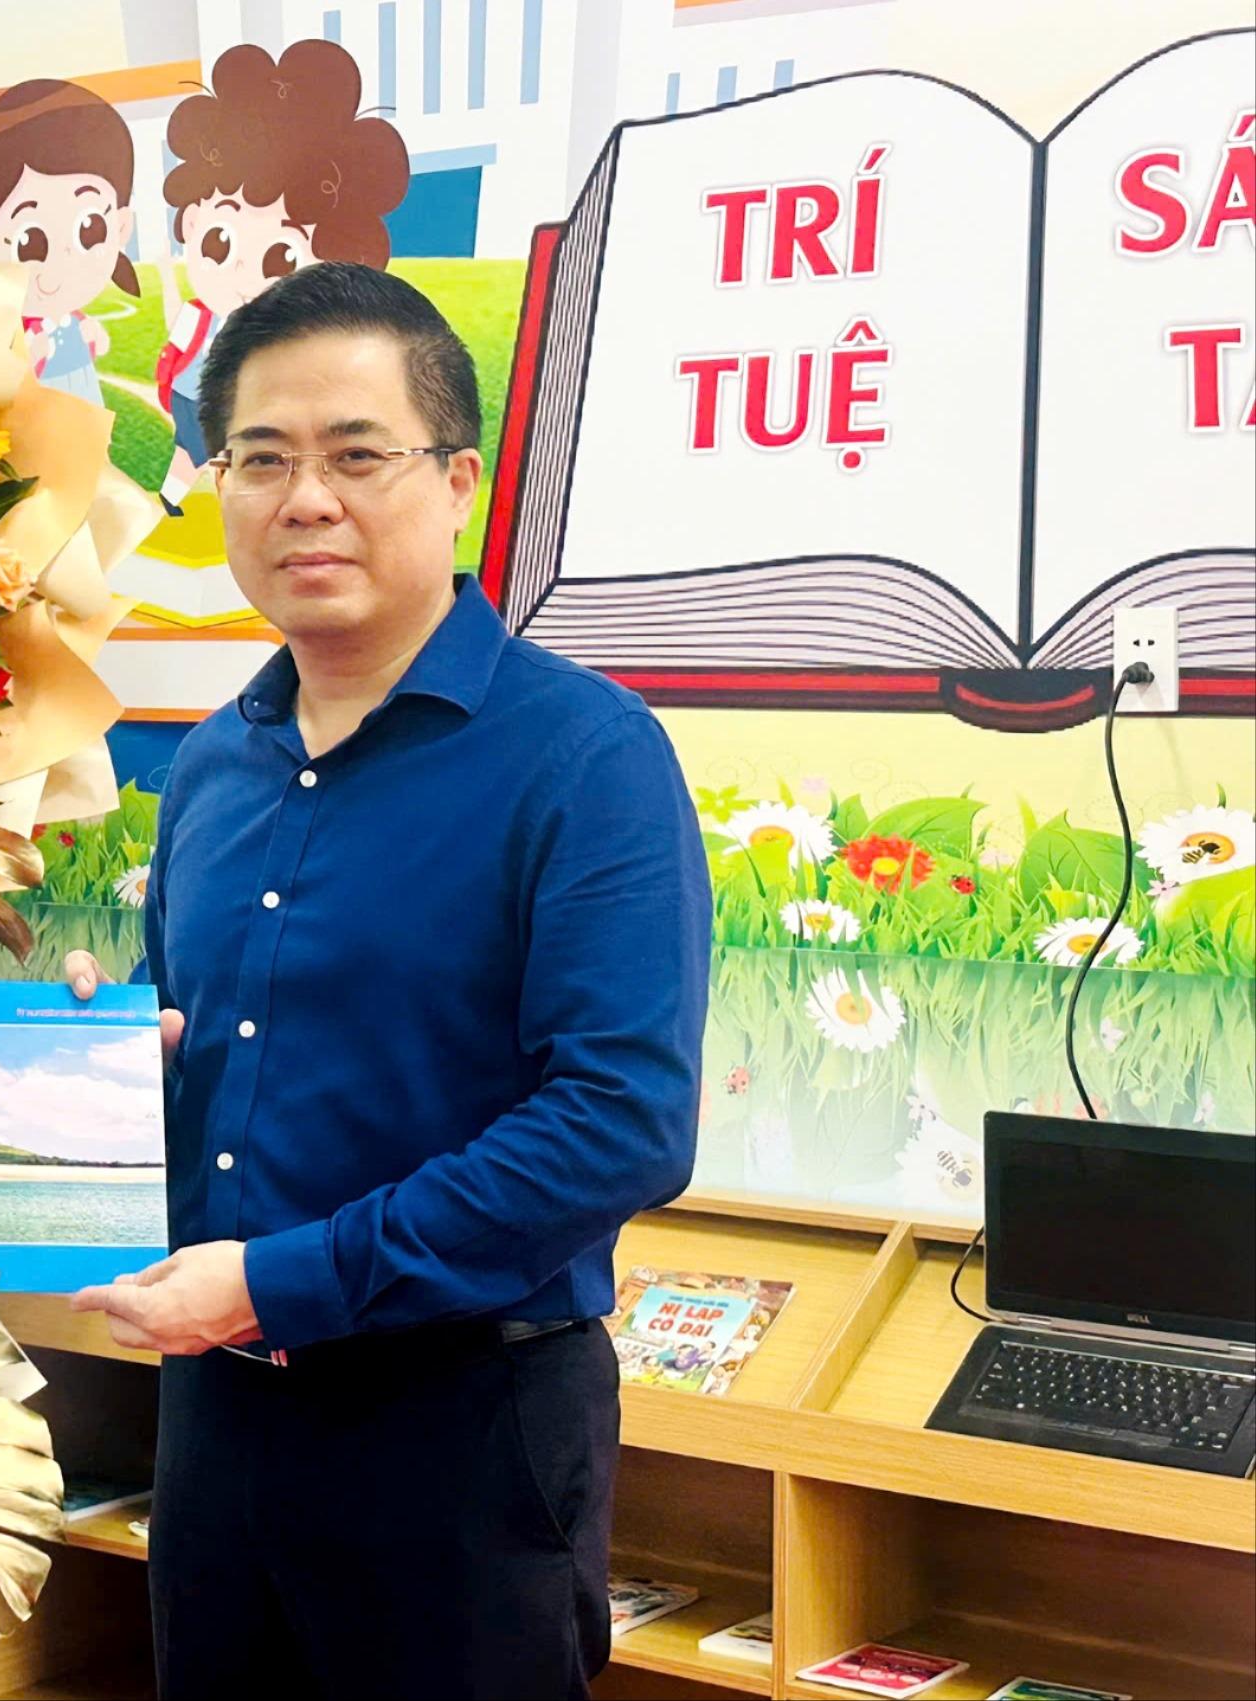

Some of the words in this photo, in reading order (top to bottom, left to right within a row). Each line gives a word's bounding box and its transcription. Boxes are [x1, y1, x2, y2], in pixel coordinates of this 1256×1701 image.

[704, 145, 888, 285] TRÍ
[677, 317, 891, 471] TUỆ
[1167, 326, 1256, 430] T
